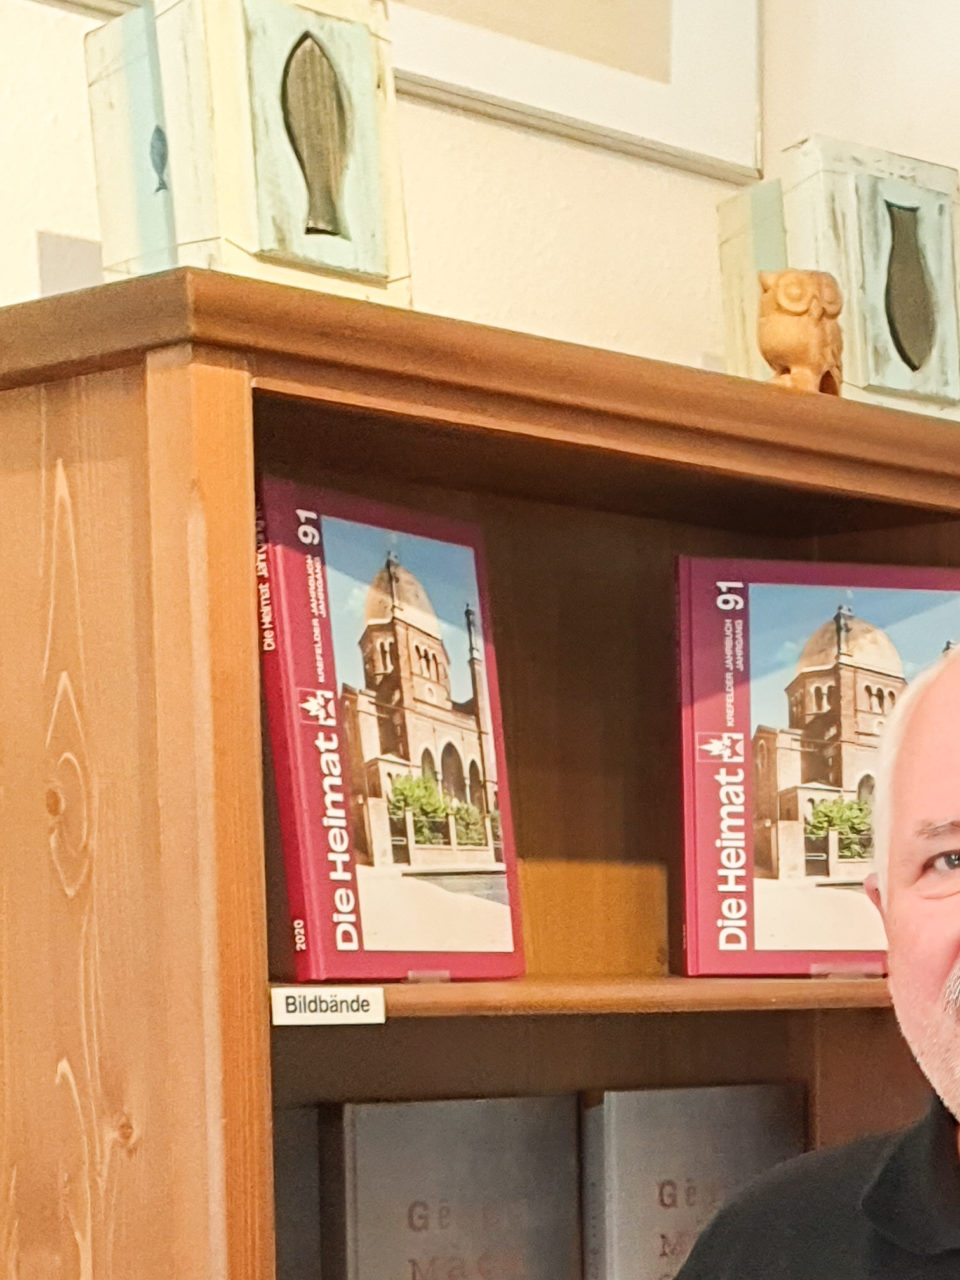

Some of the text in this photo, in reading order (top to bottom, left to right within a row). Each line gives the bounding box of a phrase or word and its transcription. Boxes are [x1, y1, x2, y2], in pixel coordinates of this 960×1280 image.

[295, 508, 320, 546] 91
[314, 556, 326, 618] JAHRGANG
[715, 580, 745, 611] 91
[263, 630, 276, 652] Die
[306, 554, 325, 683] KREFELDER JAHRBUCH
[734, 619, 744, 672] JAHRGANG
[723, 619, 735, 727] KREFELDER JAHRBUCH
[314, 731, 360, 951] Die Heimat
[713, 767, 748, 951] Die Heimat
[293, 919, 306, 952] 2020
[284, 993, 372, 1016] Bildbände
